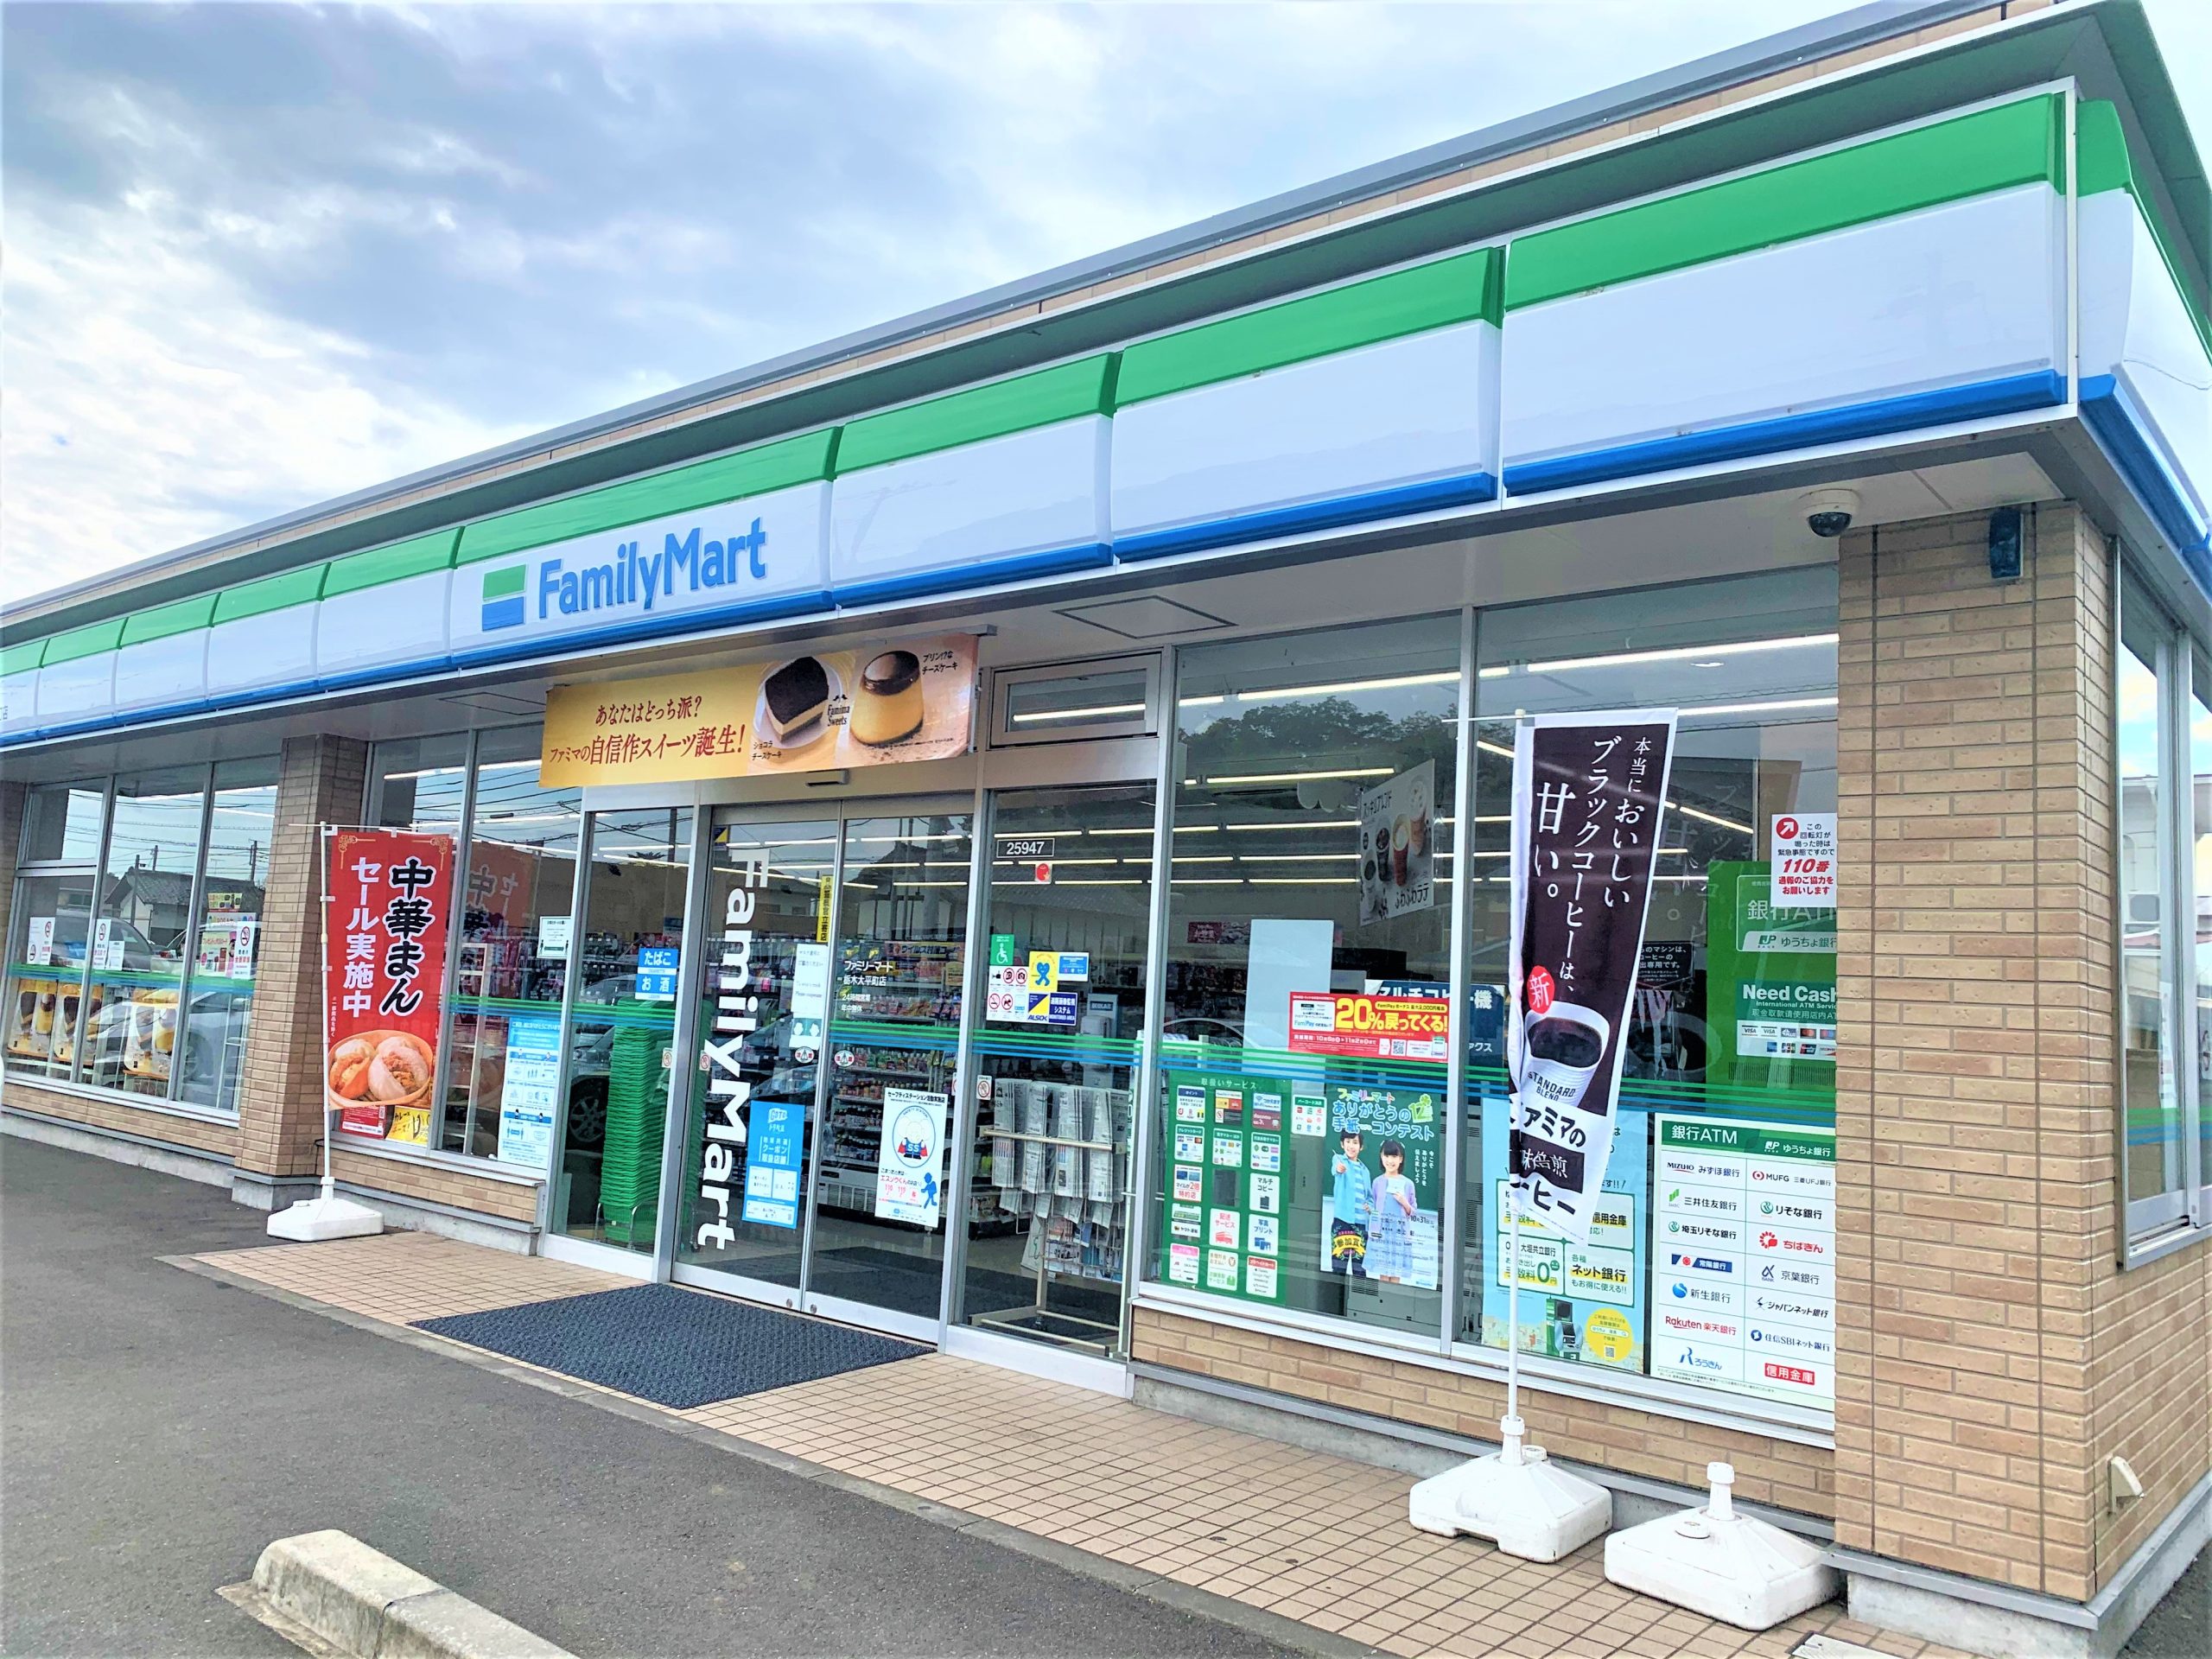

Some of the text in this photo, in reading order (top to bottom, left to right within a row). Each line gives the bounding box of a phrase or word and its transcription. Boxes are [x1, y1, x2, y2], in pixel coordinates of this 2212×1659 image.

[539, 517, 766, 619] FamilyMart
[922, 663, 958, 675] チーズケーキ
[595, 695, 702, 727] あなたはどっち派?
[827, 704, 850, 715] Famima
[827, 715, 848, 727] Sweets
[550, 724, 746, 766] ファミマの自信作スイーツ誕生!
[753, 741, 773, 750] ショコラ
[752, 750, 782, 761] チーズケーキ
[1603, 736, 1651, 908] 本当においしい
[1007, 841, 1045, 855] 25947
[1535, 782, 1576, 899] 甘い。
[1559, 735, 1622, 992] ブラックコーヒーは、
[1783, 858, 1830, 873] 110番
[1778, 876, 1834, 885] 通報のご協力を
[1783, 887, 1829, 895] お願いします
[342, 856, 382, 1018] セール実施中
[379, 856, 435, 1017] 中華まん
[1781, 938, 1837, 949] ゆうちょ銀行
[644, 950, 671, 966] たばこ
[844, 960, 893, 973] ファミリーマート
[641, 976, 671, 993] お酒
[843, 976, 887, 987] 栃木大平町店
[1529, 971, 1551, 1008] 新
[1743, 984, 1789, 1000] Need
[1335, 997, 1448, 1033] 20%戻ってくる!
[1751, 1008, 1837, 1020] 现金取款请使用店内AT
[696, 848, 771, 1250] FamilyMart
[1201, 1078, 1257, 1090] 取扱いサービス
[1528, 1071, 1576, 1098] STANDARD
[1337, 1088, 1395, 1104] ファミリーマート
[1535, 1086, 1560, 1102] BLEND
[1332, 1100, 1412, 1122] ありがとうの
[1521, 1105, 1586, 1147] ァミマの
[907, 1143, 920, 1153] SS
[1672, 1124, 1738, 1145] 銀行ATM
[1783, 1143, 1832, 1157] ゆうちょ銀行
[762, 1144, 787, 1154] クーポン
[1667, 1161, 1740, 1178] MIZUHO みずほ銀行
[1765, 1173, 1832, 1186] MUFG 三菱UFJ銀行
[1684, 1197, 1738, 1211] 三井住友銀行
[1593, 1212, 1627, 1226] 信用金庫
[1776, 1205, 1822, 1220] りそな銀行
[1681, 1224, 1737, 1240] 埼玉りそな銀行
[1520, 1243, 1556, 1257] 大垣共立銀行
[1783, 1240, 1823, 1254] ちばぎん
[1572, 1254, 1587, 1263] 各種
[1572, 1265, 1627, 1282] ネット銀行
[1781, 1270, 1820, 1285] 京葉銀行
[1572, 1280, 1627, 1294] もお得に使える!!
[1690, 1288, 1731, 1304] 新生銀行
[1767, 1301, 1829, 1319] ジャパンネット銀行
[1665, 1316, 1737, 1336] Rakuten 楽天銀行
[1764, 1333, 1830, 1352] 住信SBIネット銀行
[1694, 1357, 1722, 1370] ろうきん
[1766, 1365, 1815, 1383] 信用金庫
